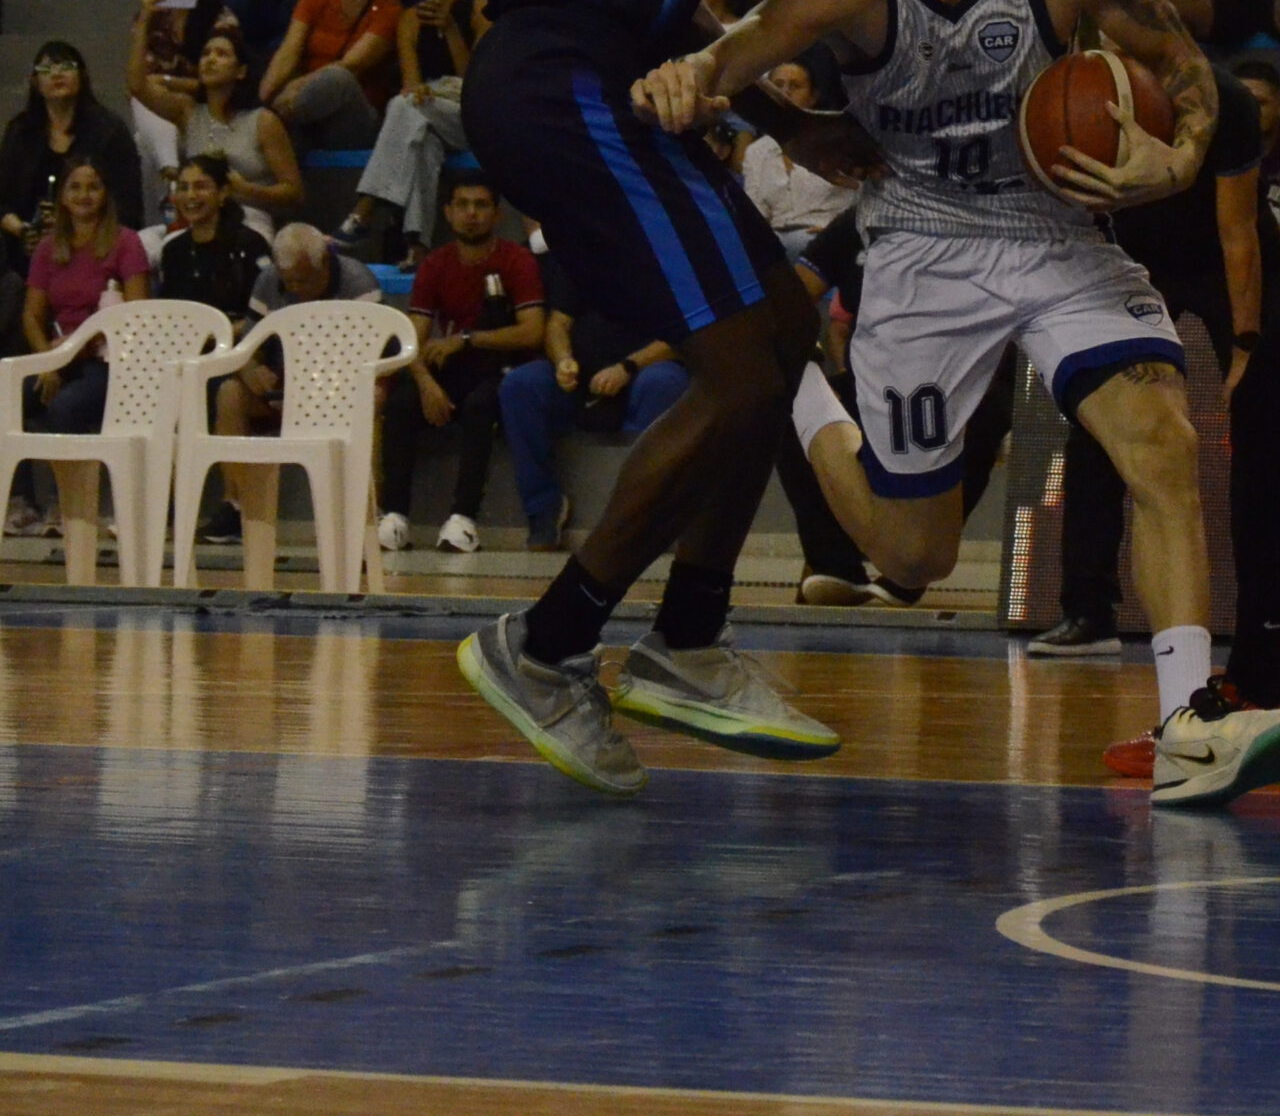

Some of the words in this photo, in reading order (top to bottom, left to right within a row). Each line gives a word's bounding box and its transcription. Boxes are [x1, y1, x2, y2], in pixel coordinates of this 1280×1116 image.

[984, 34, 1014, 49] CAR
[934, 136, 992, 180] 10
[1132, 304, 1162, 315] CAR
[882, 381, 950, 455] 10
